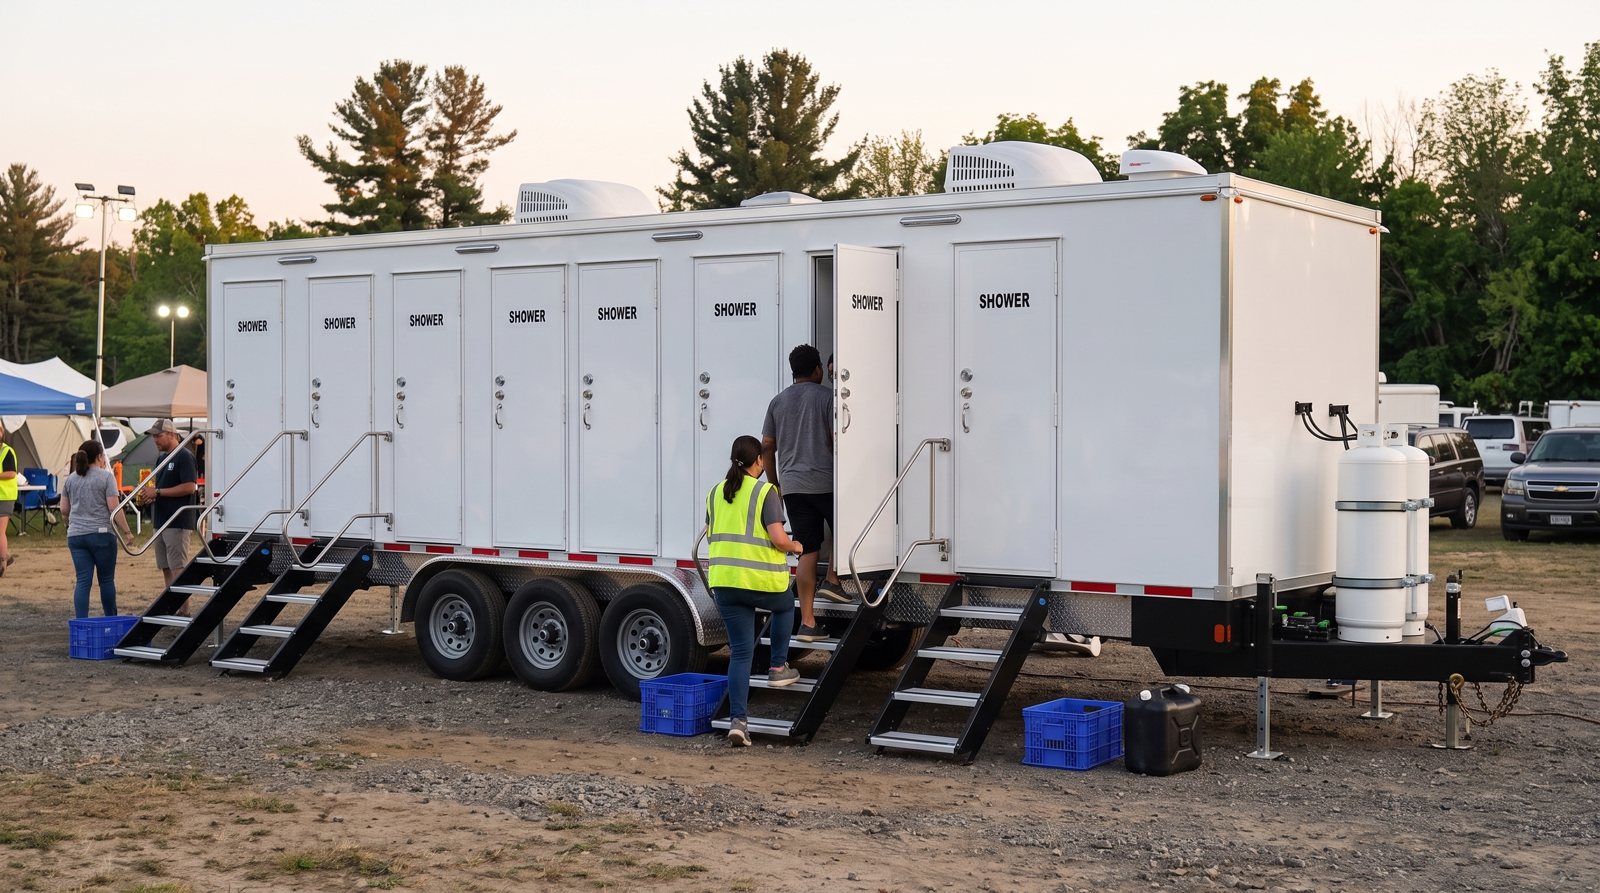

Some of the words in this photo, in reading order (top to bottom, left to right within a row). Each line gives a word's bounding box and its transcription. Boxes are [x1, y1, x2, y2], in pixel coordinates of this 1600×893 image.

[852, 294, 883, 311] SHOWER
[979, 293, 1030, 309] SHOWER
[598, 306, 637, 320] SHOWER
[714, 302, 757, 317] SHOWER
[324, 317, 355, 329] SHOWER
[410, 314, 443, 327] SHOWER
[509, 310, 546, 324] SHOWER
[238, 320, 267, 332] SHOWER
